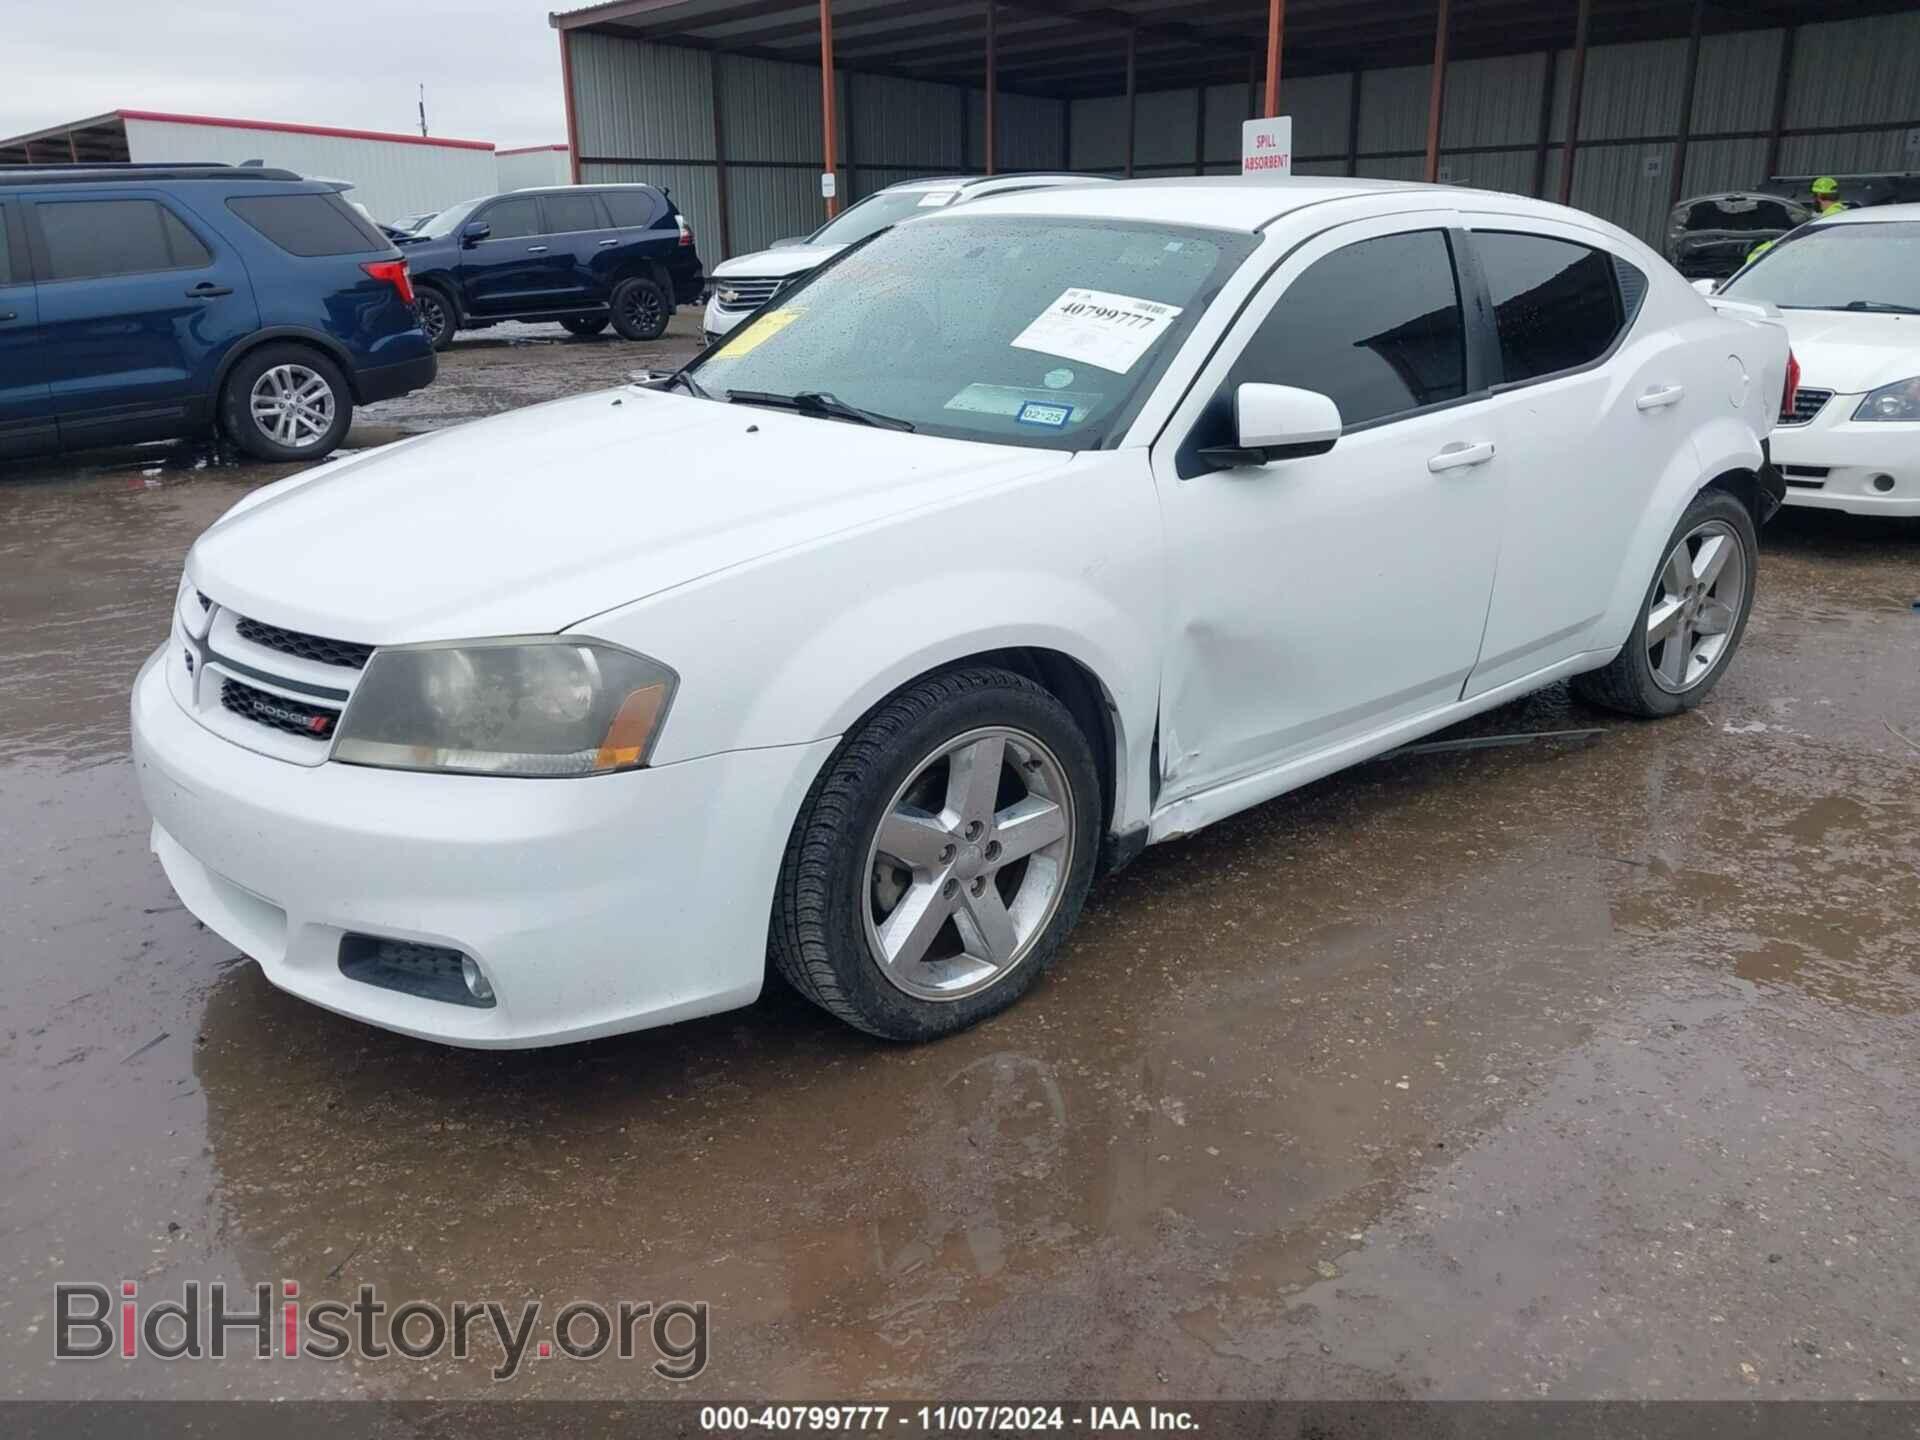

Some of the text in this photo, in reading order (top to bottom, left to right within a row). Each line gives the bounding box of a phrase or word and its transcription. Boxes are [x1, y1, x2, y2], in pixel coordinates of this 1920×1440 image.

[1256, 134, 1276, 148] SPILL
[1245, 154, 1289, 171] ABSORBENT
[1060, 302, 1155, 329] 40799777
[253, 701, 313, 725] DODGE
